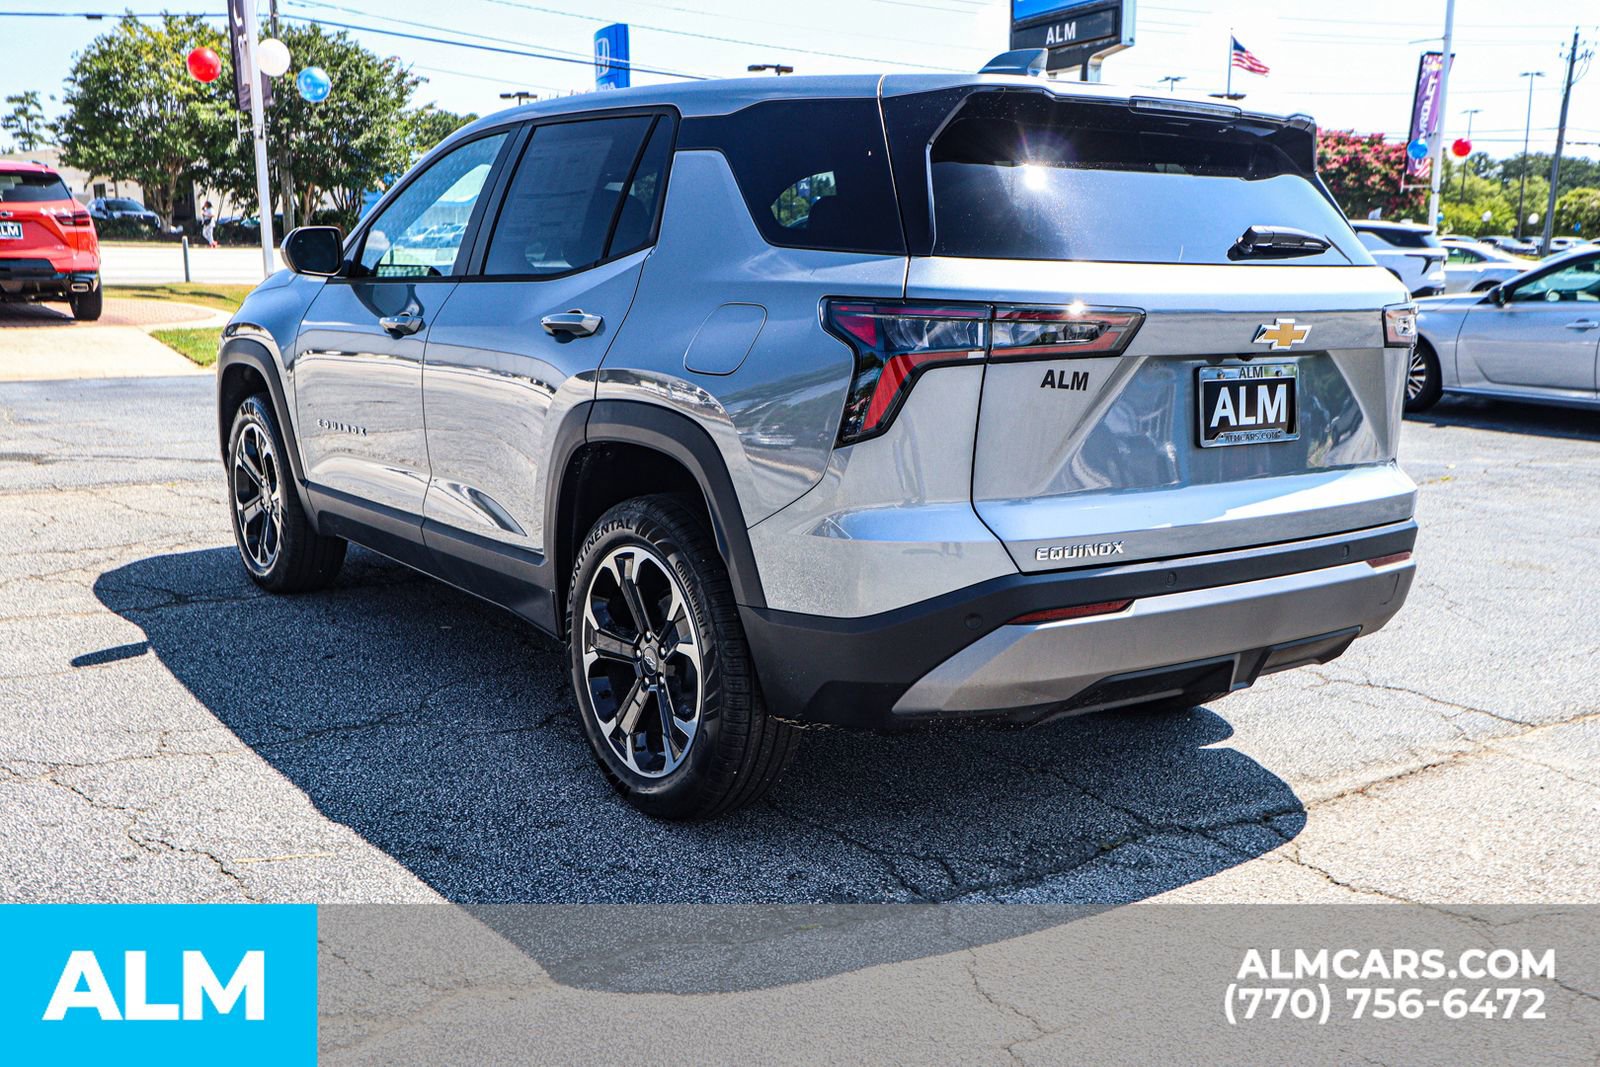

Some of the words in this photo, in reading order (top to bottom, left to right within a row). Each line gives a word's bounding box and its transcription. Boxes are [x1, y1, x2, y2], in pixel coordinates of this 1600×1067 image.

[1046, 21, 1077, 45] ALM
[0, 224, 19, 236] LM
[1040, 369, 1089, 391] ALM
[1239, 366, 1264, 378] ALM
[1210, 384, 1287, 427] ALM
[569, 518, 633, 605] CONTINENTAL
[1035, 540, 1125, 561] EQUINOX
